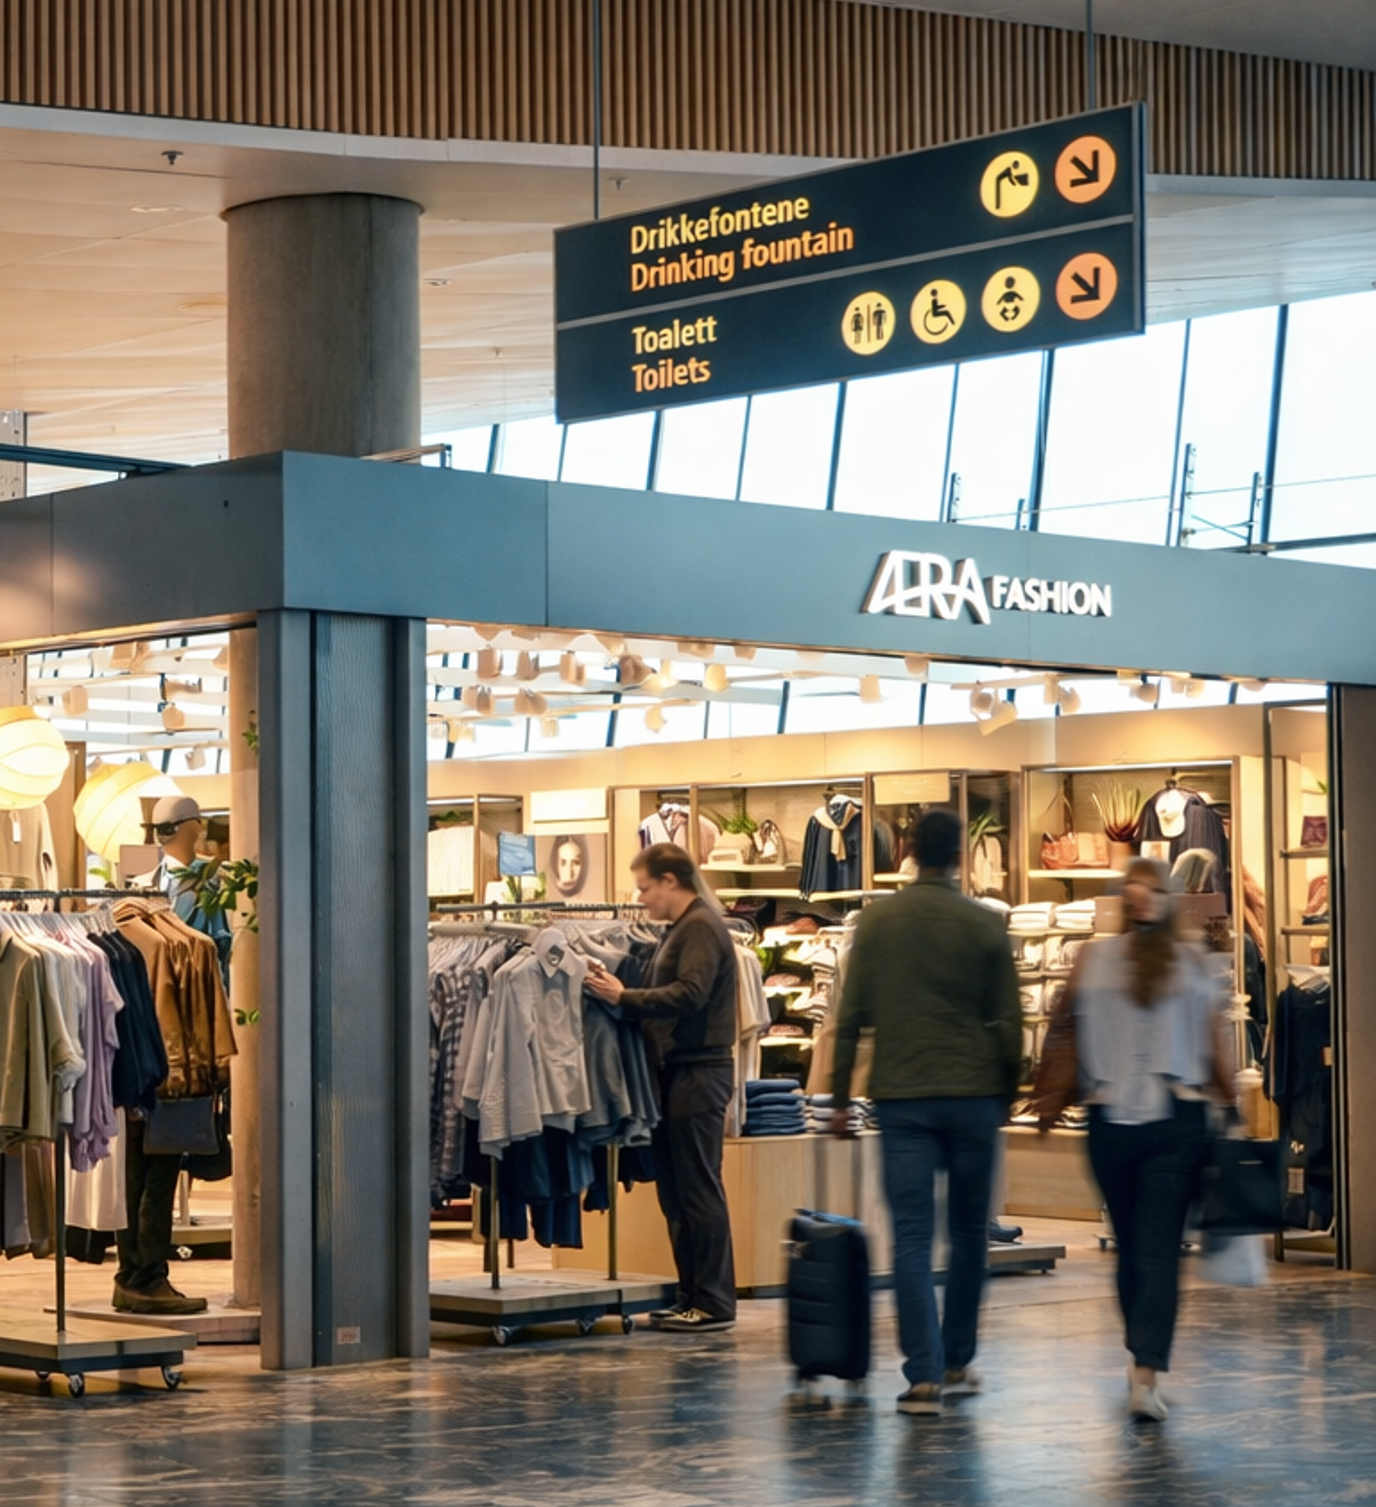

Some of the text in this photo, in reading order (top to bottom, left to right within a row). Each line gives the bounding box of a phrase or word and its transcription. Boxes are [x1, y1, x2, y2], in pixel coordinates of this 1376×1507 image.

[631, 197, 810, 254] Drikkefontene
[631, 221, 854, 292] Drinking fountain
[631, 315, 717, 355] Toalett
[631, 356, 711, 392] Toilets
[991, 575, 1112, 618] FASHION
